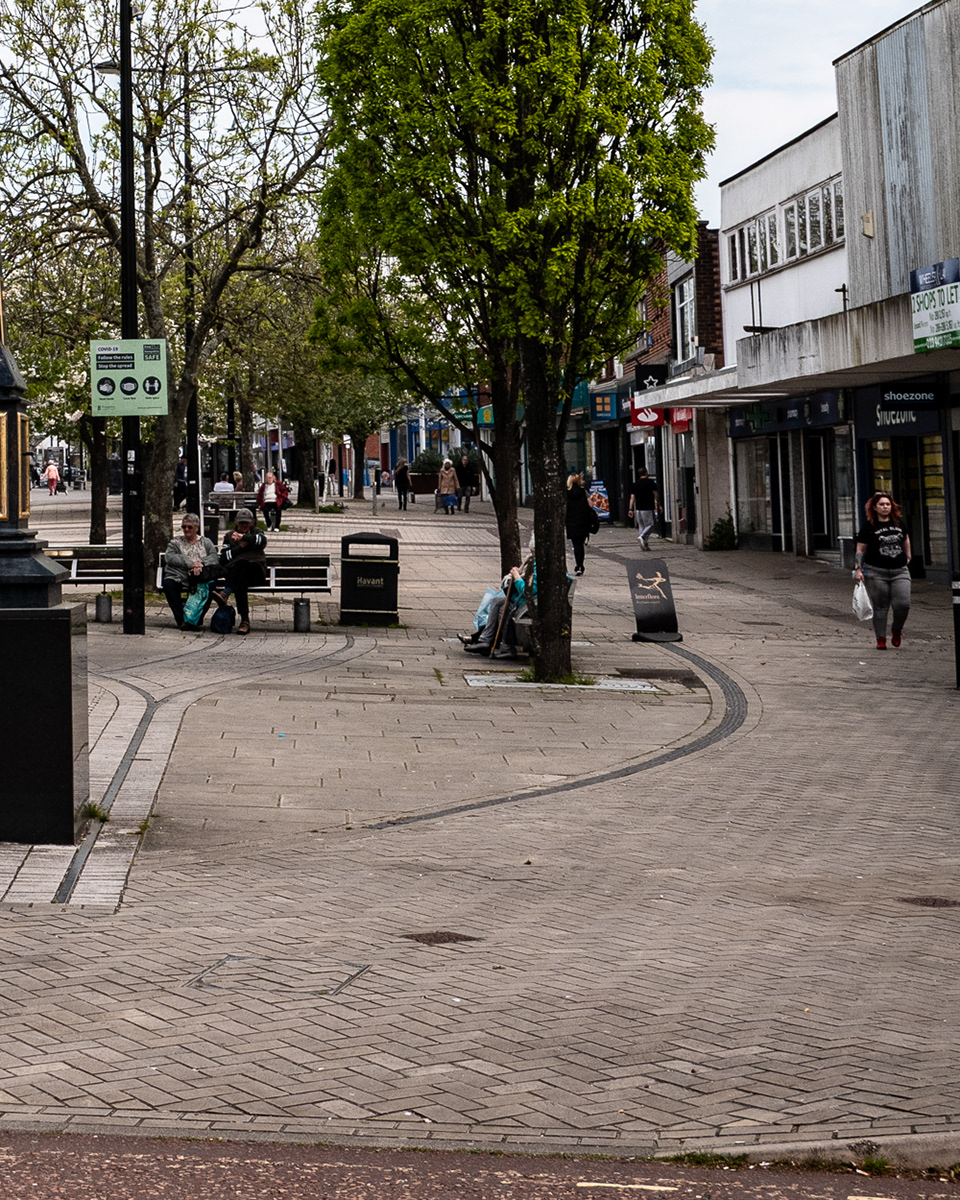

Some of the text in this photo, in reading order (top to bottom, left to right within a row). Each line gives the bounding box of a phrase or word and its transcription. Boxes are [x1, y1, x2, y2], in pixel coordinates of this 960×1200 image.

[916, 291, 937, 312] SHOPS
[937, 288, 946, 306] TO
[946, 285, 959, 305] LET
[884, 391, 935, 401] shoezone
[357, 576, 384, 585] Havant
